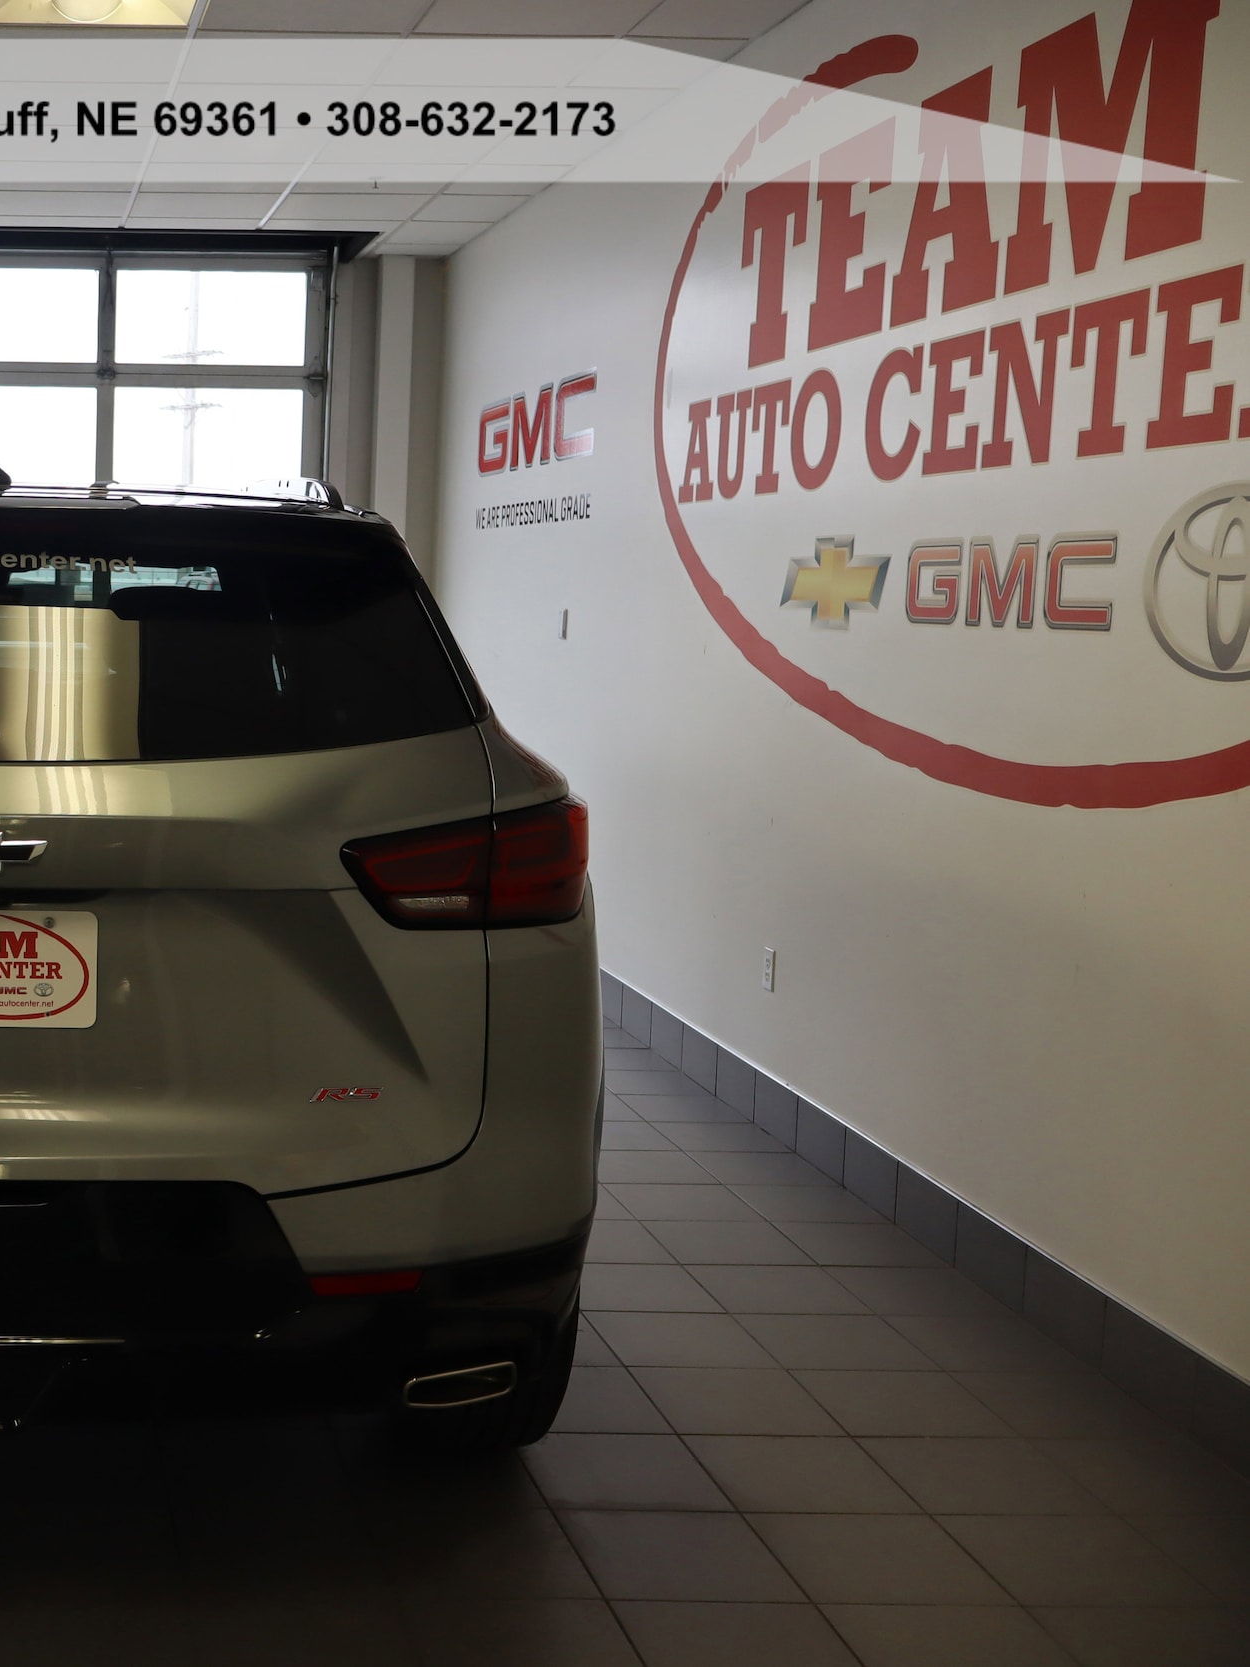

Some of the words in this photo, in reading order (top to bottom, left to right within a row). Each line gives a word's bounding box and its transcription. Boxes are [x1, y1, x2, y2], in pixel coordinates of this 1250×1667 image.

[741, 0, 1221, 370] TEAM
[478, 366, 598, 478] GMC
[678, 368, 842, 504] AUTO
[865, 264, 1250, 482] CENTE
[475, 507, 486, 530] WE
[486, 505, 501, 529] ARE
[501, 498, 558, 528] PROFESSIONAL
[560, 493, 591, 521] GRADE
[905, 531, 1118, 632] GMC
[309, 1087, 383, 1102] RS
